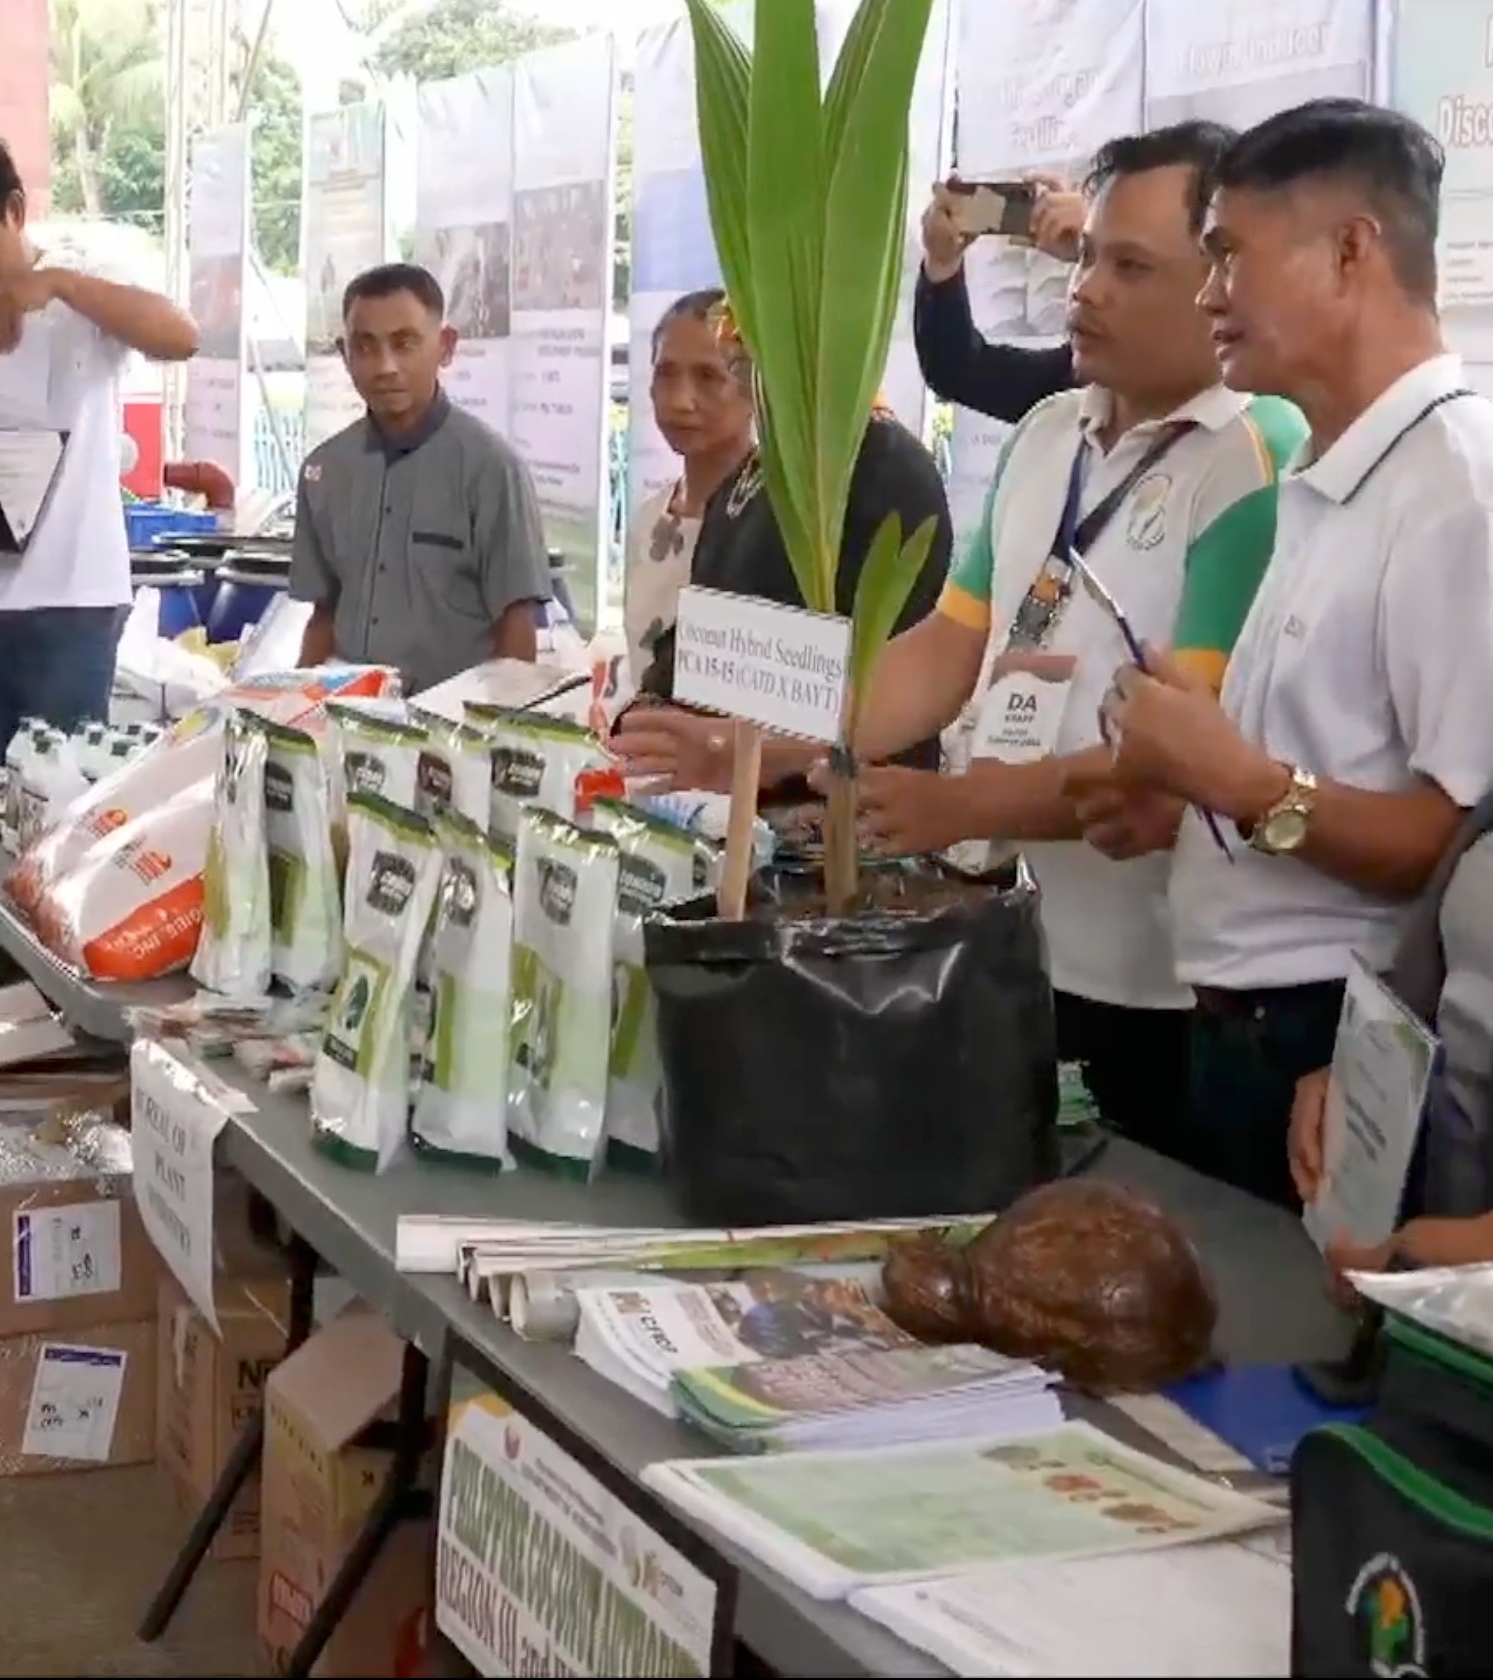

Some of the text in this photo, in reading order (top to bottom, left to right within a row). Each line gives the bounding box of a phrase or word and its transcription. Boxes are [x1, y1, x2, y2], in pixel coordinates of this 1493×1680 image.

[730, 627, 772, 661] Hybrid
[774, 638, 842, 683] Seedlings
[1008, 692, 1037, 712] DA
[438, 1535, 497, 1654] REGION
